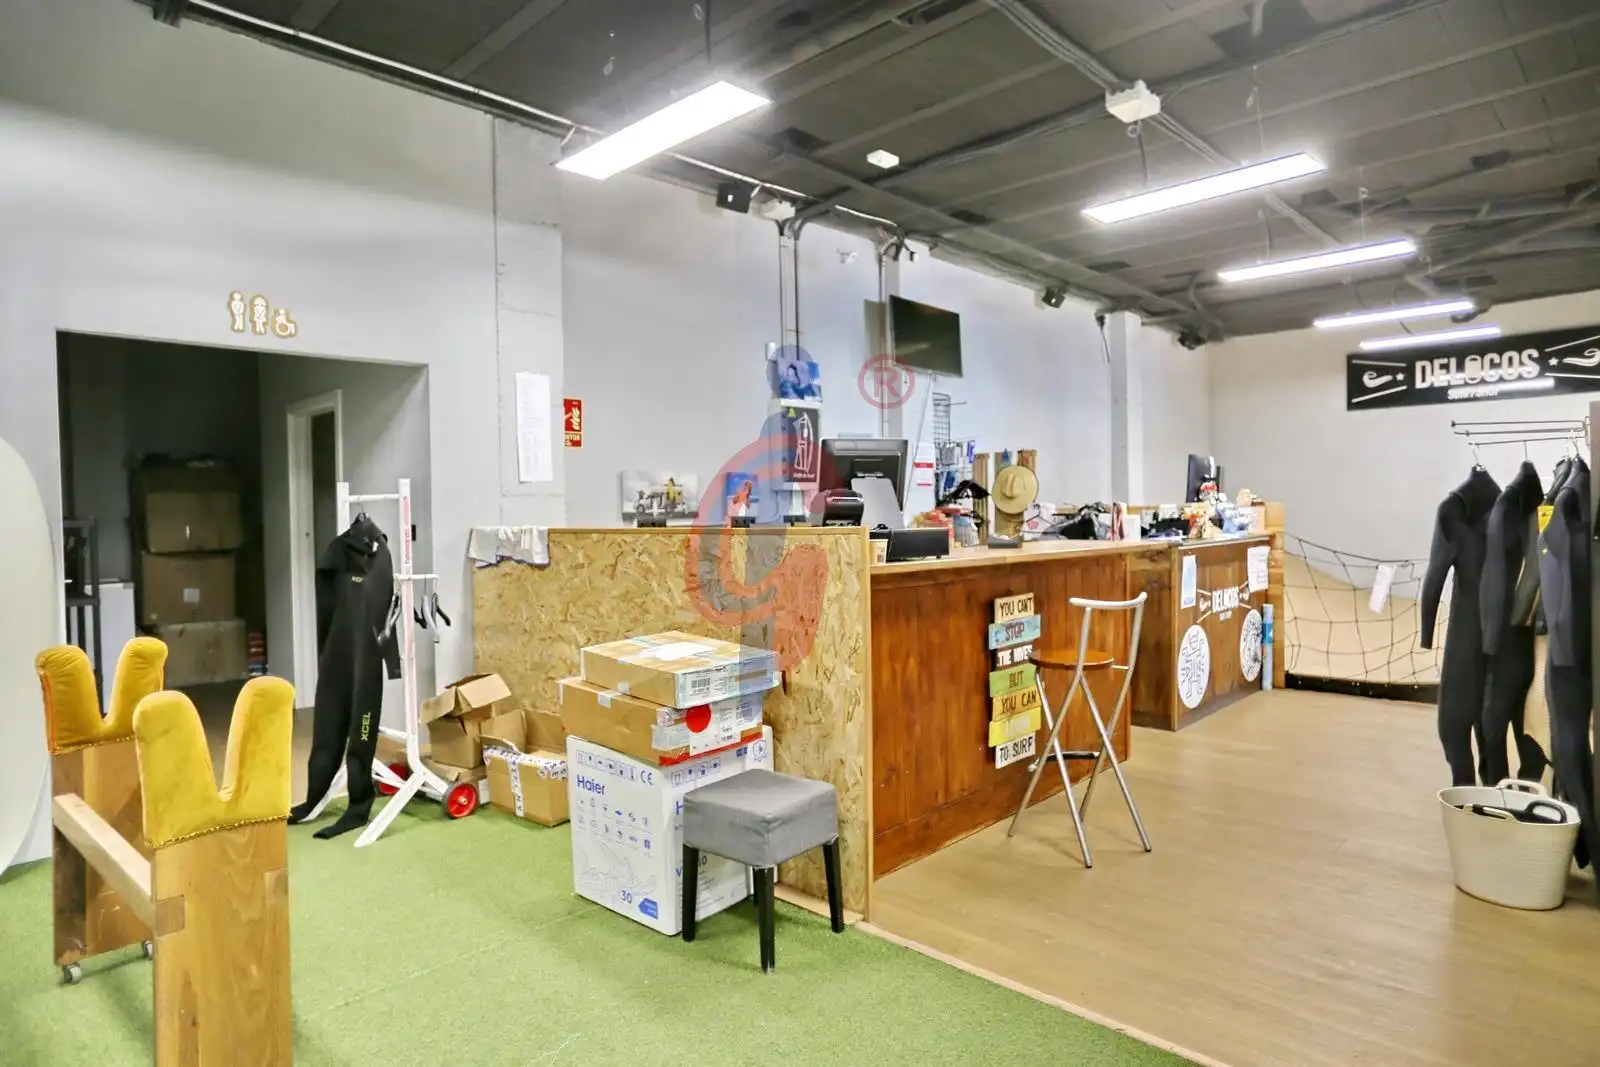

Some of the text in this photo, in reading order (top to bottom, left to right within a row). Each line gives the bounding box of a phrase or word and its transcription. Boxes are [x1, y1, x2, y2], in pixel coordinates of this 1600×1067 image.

[1415, 349, 1540, 389] DELOCOS
[1000, 600, 1014, 617] YOU
[1004, 622, 1025, 641] STOP
[1009, 670, 1024, 688] BUT
[1001, 691, 1037, 714] YOU CAN
[361, 711, 371, 741] XCEL
[999, 736, 1033, 762] TO SURF
[576, 773, 605, 796] Haier
